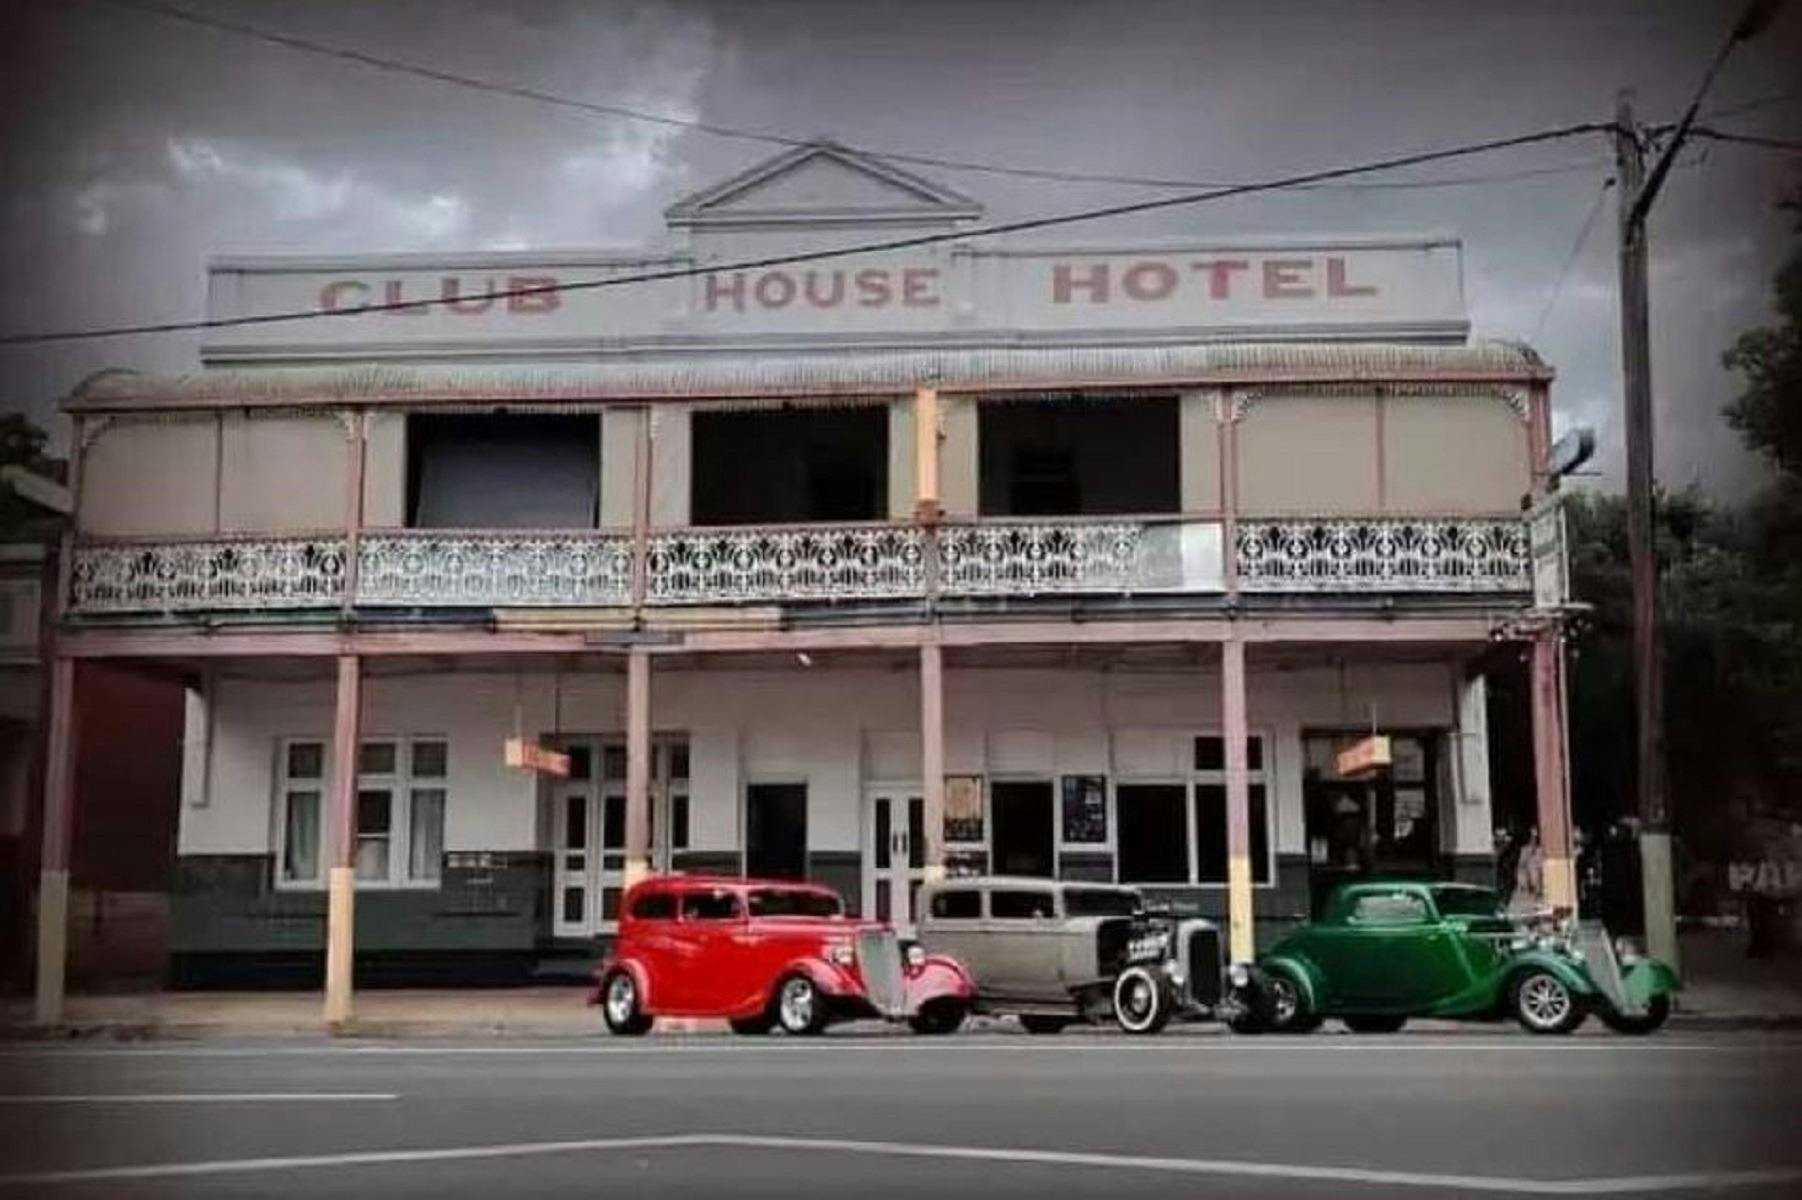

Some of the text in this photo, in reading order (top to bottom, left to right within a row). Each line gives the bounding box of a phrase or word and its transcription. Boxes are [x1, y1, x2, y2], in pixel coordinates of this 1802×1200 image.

[320, 257, 1378, 316] CLUB HOUSE HOTEL
